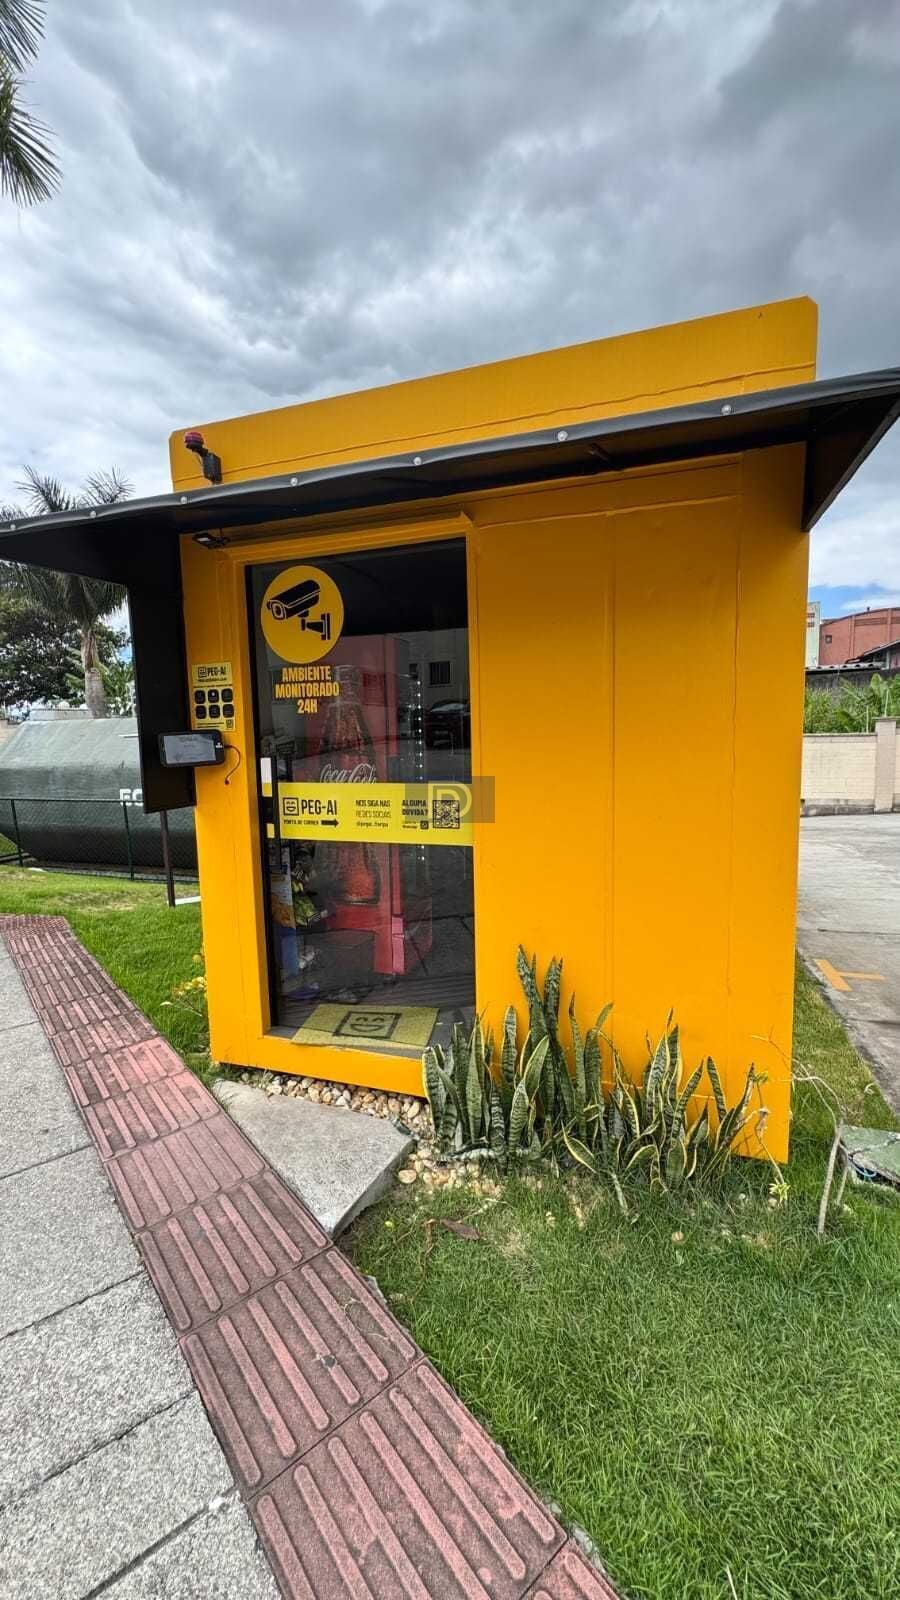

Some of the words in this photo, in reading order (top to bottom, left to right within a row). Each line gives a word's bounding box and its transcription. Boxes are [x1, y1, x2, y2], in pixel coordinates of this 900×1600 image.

[282, 666, 332, 682] AMBIENTE
[275, 682, 340, 699] MONITORADO
[297, 699, 318, 714] 24H
